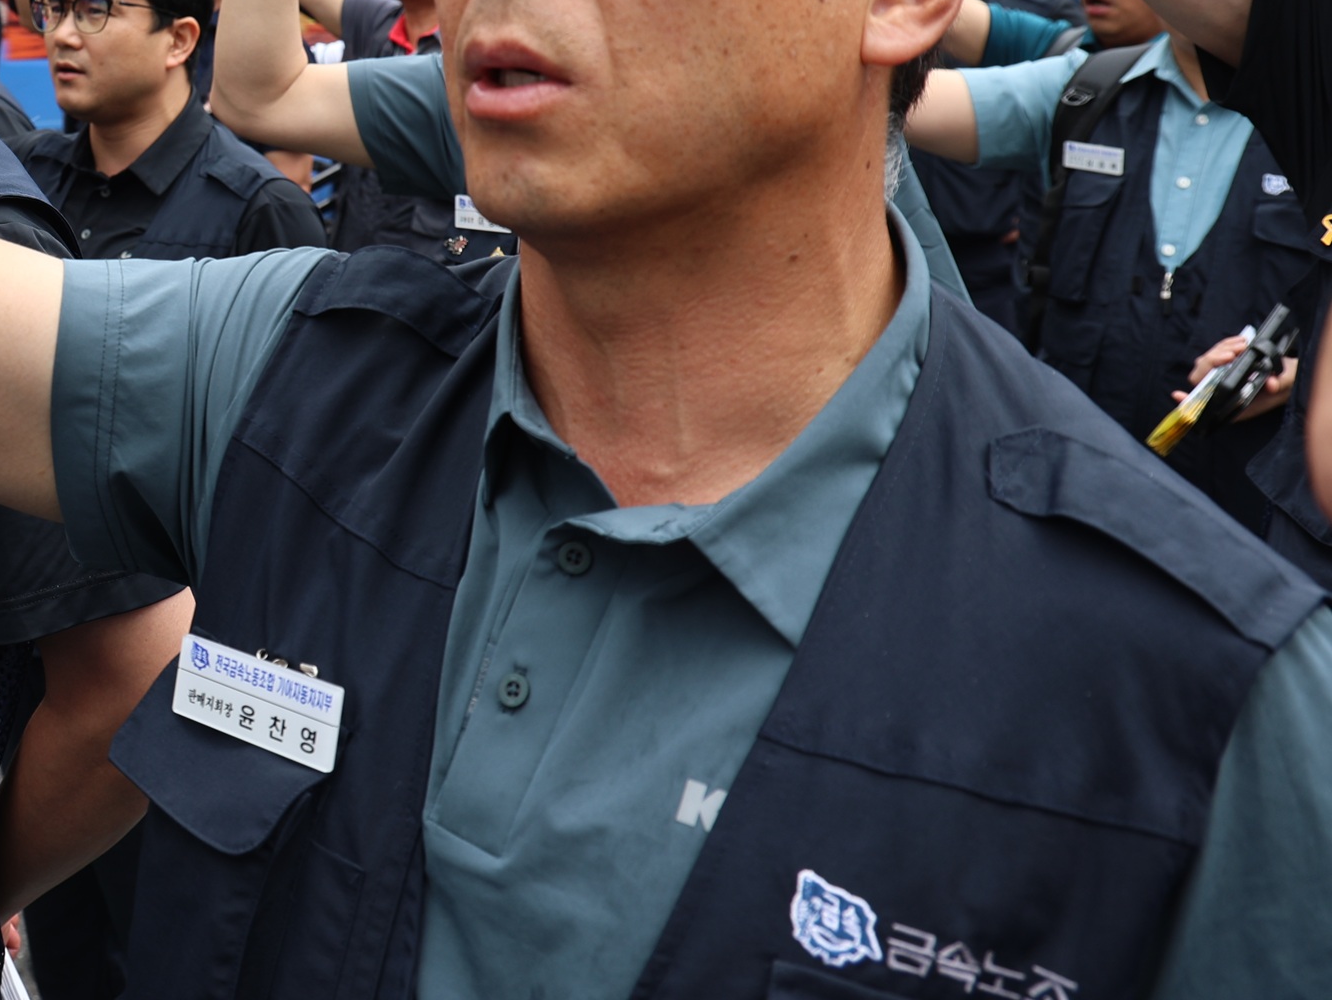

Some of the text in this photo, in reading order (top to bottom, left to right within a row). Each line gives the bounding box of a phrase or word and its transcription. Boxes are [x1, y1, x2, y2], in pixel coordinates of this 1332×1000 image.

[187, 688, 234, 718] 판매지회장
[214, 654, 333, 713] 전국금속노동조합 기아자동차지부
